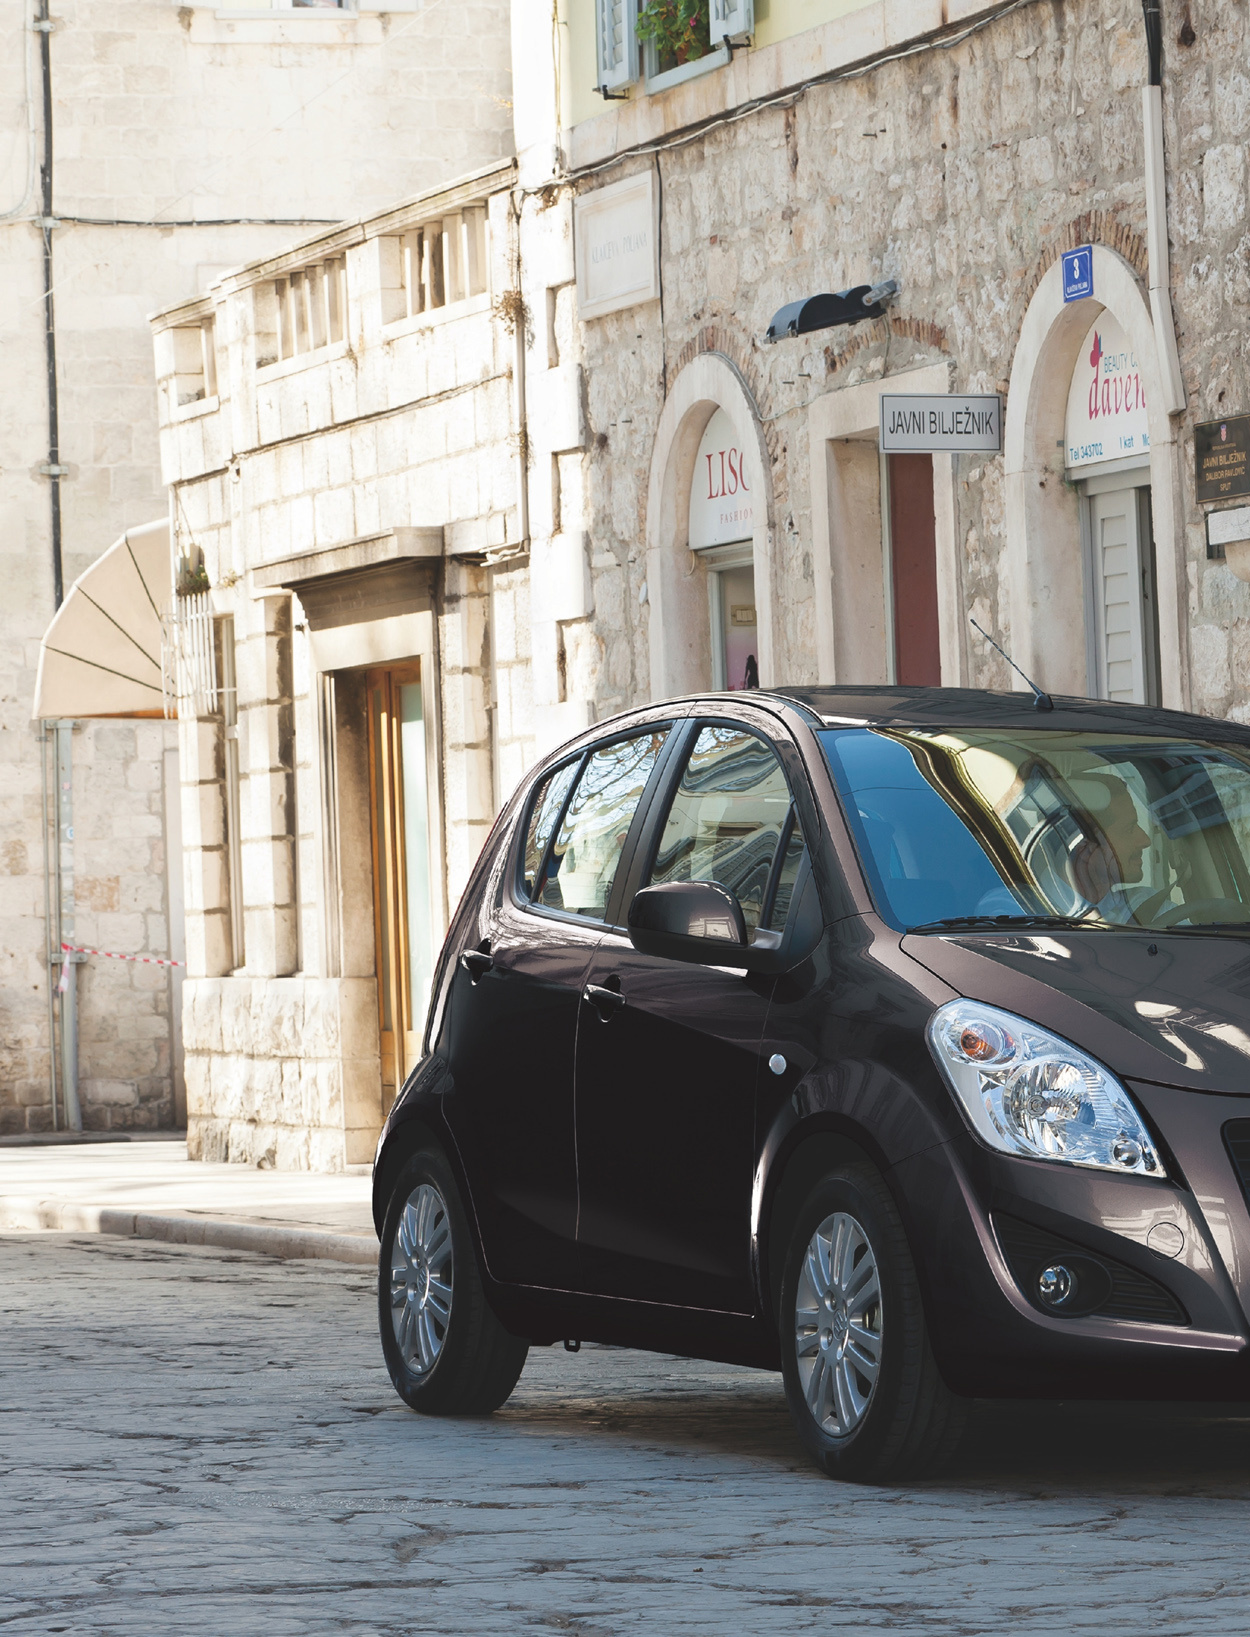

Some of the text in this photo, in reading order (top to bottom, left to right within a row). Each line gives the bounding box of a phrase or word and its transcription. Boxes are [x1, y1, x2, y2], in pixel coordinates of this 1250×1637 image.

[1073, 258, 1080, 279] 3
[1104, 352, 1128, 373] BEAUTY
[889, 406, 994, 435] JAVNI BILJEŽNIK
[1070, 448, 1080, 461] Tel
[1081, 443, 1103, 459] 343702
[1124, 436, 1134, 448] kat
[1203, 456, 1218, 469] JAVNI
